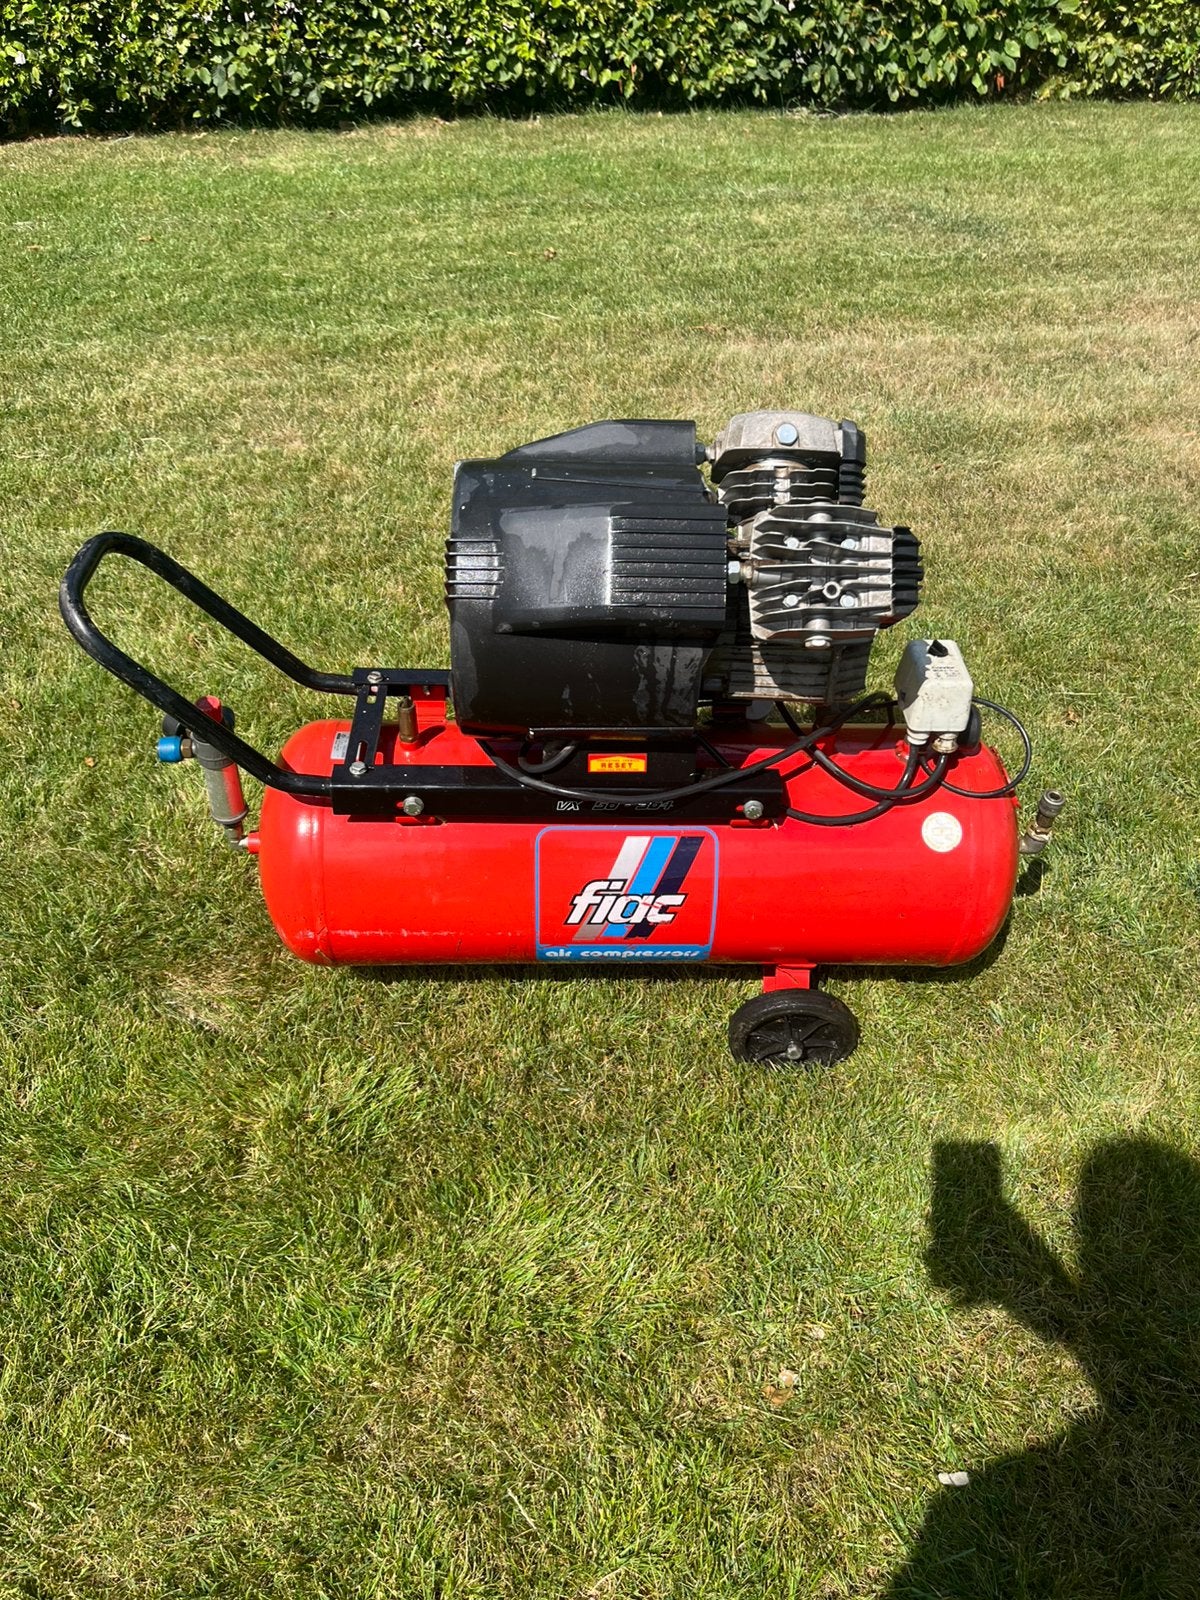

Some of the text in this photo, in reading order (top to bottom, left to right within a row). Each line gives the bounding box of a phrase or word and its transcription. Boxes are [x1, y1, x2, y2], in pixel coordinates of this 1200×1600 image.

[556, 800, 583, 811] VX
[563, 879, 689, 925] fiac
[545, 948, 701, 959] air compressors
